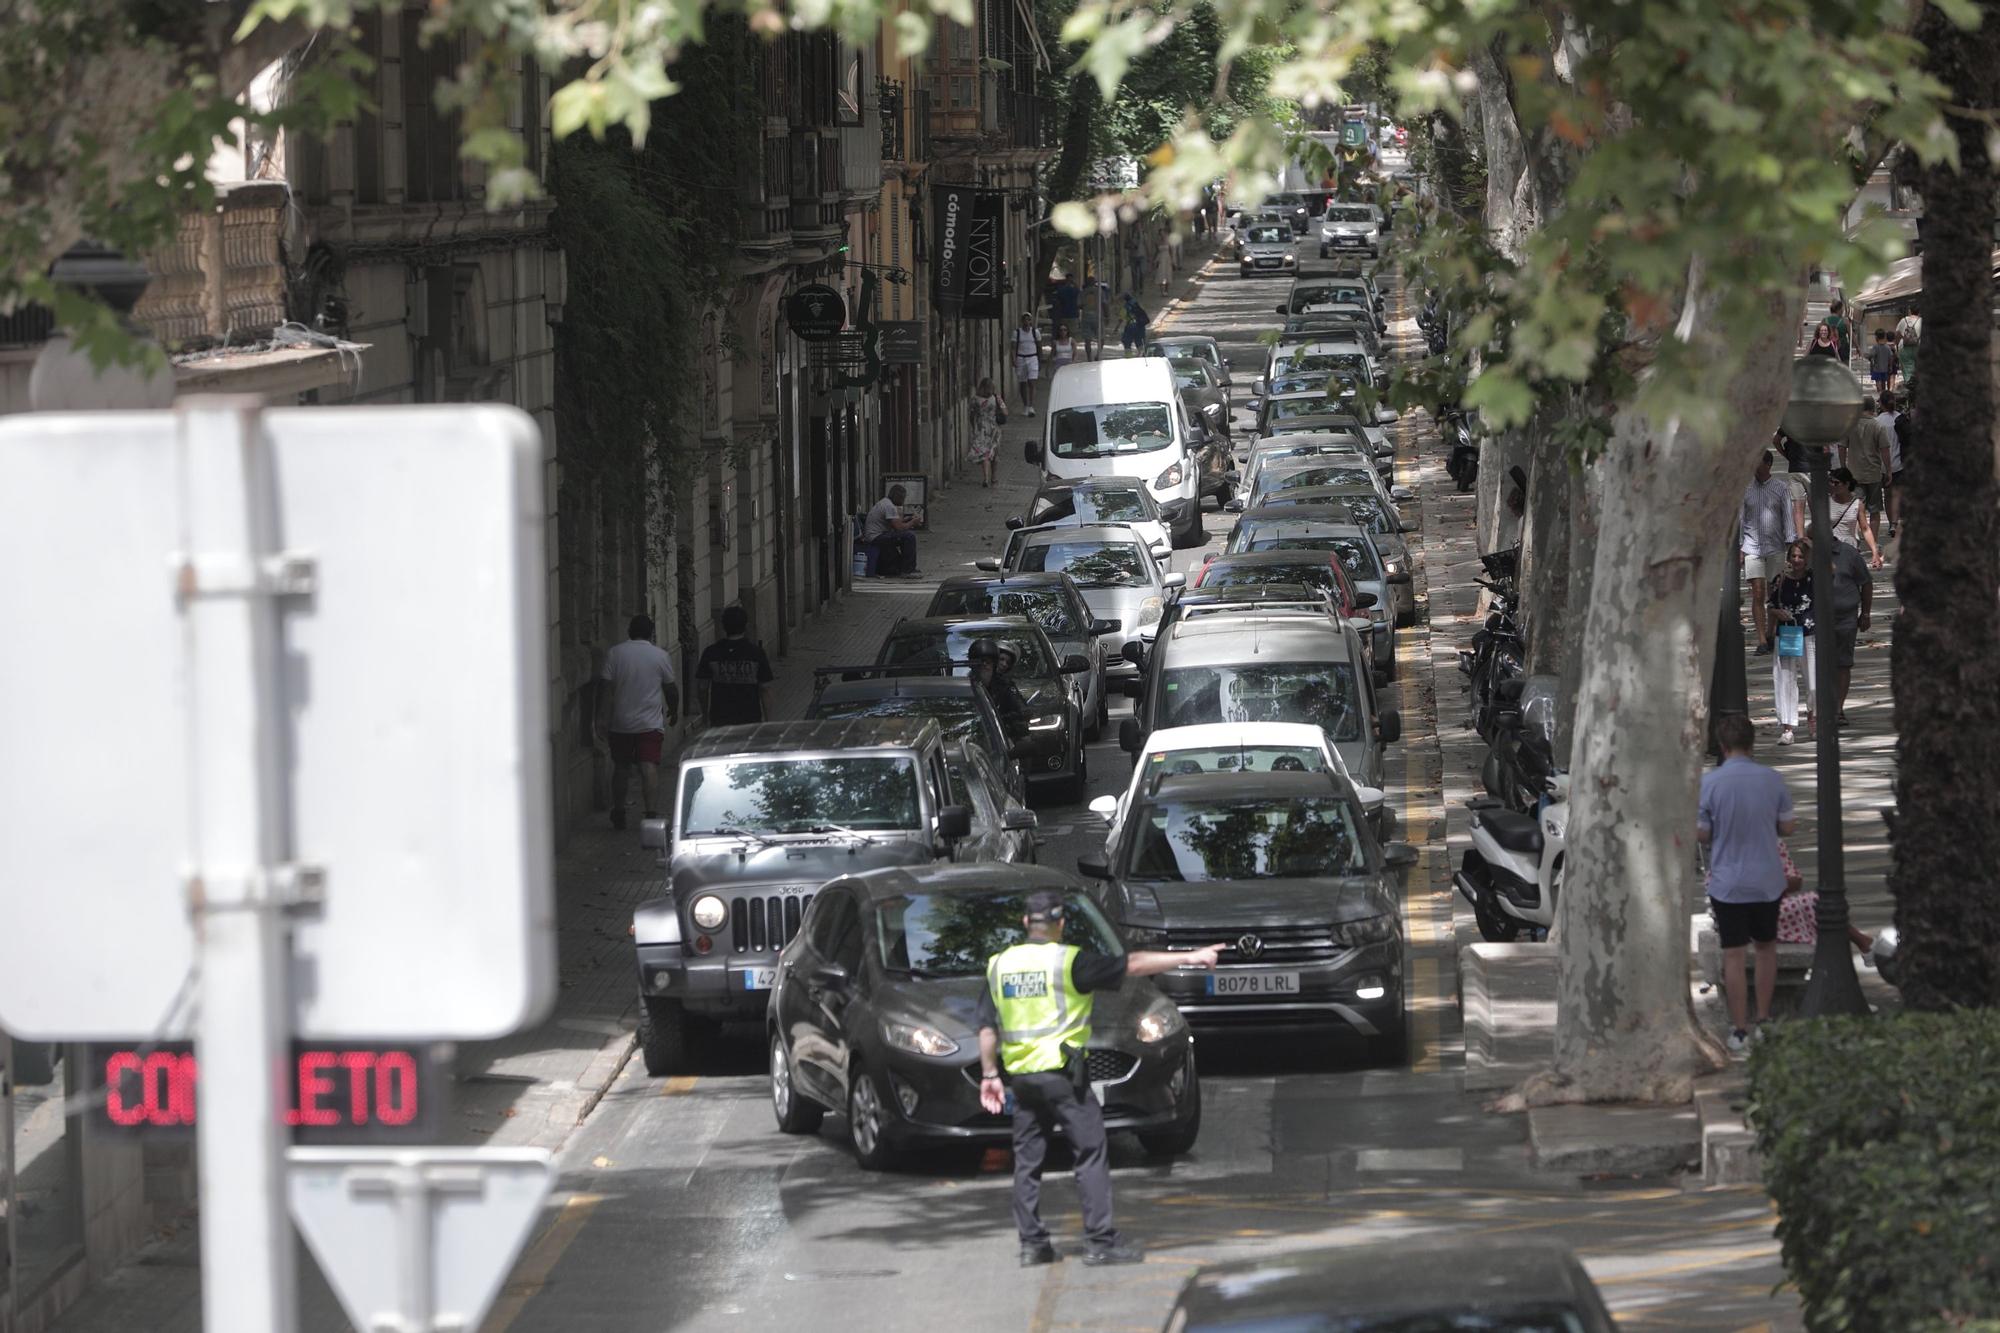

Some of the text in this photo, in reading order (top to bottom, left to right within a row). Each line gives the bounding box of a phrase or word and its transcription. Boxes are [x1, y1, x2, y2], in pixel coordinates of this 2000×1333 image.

[1015, 984, 1047, 999] LOCAL
[1217, 974, 1295, 993] 8078 LRL
[106, 1050, 418, 1127] COLETO
